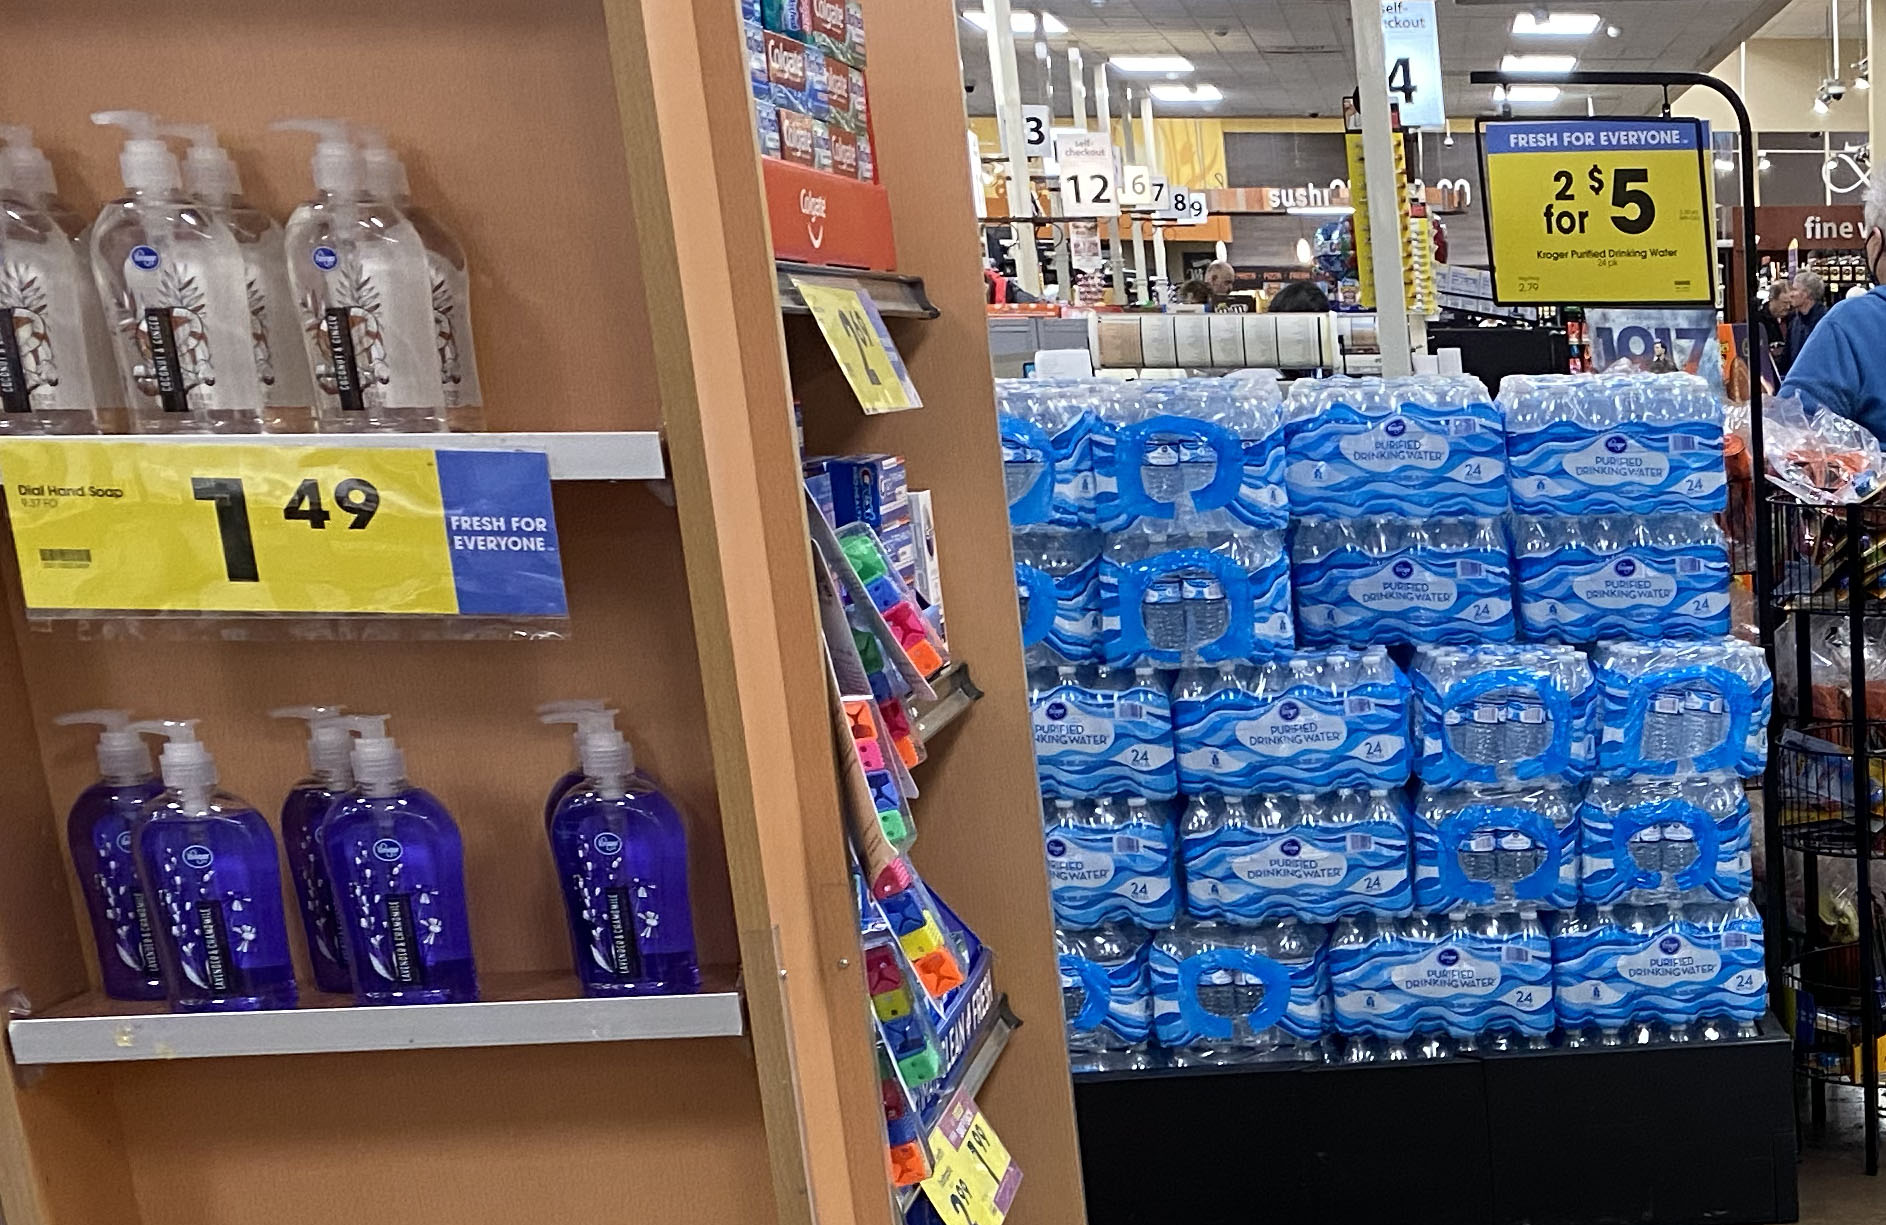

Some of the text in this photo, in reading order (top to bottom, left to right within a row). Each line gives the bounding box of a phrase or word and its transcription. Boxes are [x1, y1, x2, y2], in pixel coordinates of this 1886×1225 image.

[813, 0, 845, 26] Colgate
[1384, 16, 1426, 29] ckout
[768, 39, 804, 78] Colgate
[1388, 57, 1418, 104] 4
[1025, 116, 1046, 145] 3
[1509, 129, 1681, 148] FRESH FOR EVERYONE
[831, 135, 858, 169] Colgate
[1065, 148, 1105, 157] checkout
[1066, 174, 1111, 204] 12
[1131, 174, 1147, 195] 6
[1152, 183, 1164, 202] 7
[1174, 193, 1187, 212] 8
[1268, 182, 1330, 208] sushi
[1553, 164, 1656, 235] 2 $ 5
[799, 188, 827, 222] Colgate
[1190, 200, 1203, 217] 9
[1544, 203, 1588, 235] for
[1804, 216, 1854, 240] fine
[1536, 247, 1678, 262] Kroger Purified Drinking Water
[1518, 283, 1539, 293] 2.79
[1595, 456, 1644, 468] PURIFIED
[1628, 464, 1663, 477] WATER
[18, 484, 123, 499] Dial Hand Soap
[1686, 478, 1704, 491] 24
[191, 477, 380, 583] 1 49
[450, 516, 547, 532] FRESH FOR
[453, 535, 546, 552] EVERYONE
[1270, 722, 1317, 735] PURIFIED
[1303, 731, 1340, 744] WATER
[1365, 741, 1382, 755] 24
[1650, 956, 1694, 968] PURIFIED
[1680, 963, 1715, 976] WATER
[1736, 974, 1754, 987] 24
[971, 1123, 991, 1153] 99
[955, 1178, 974, 1206] 99
